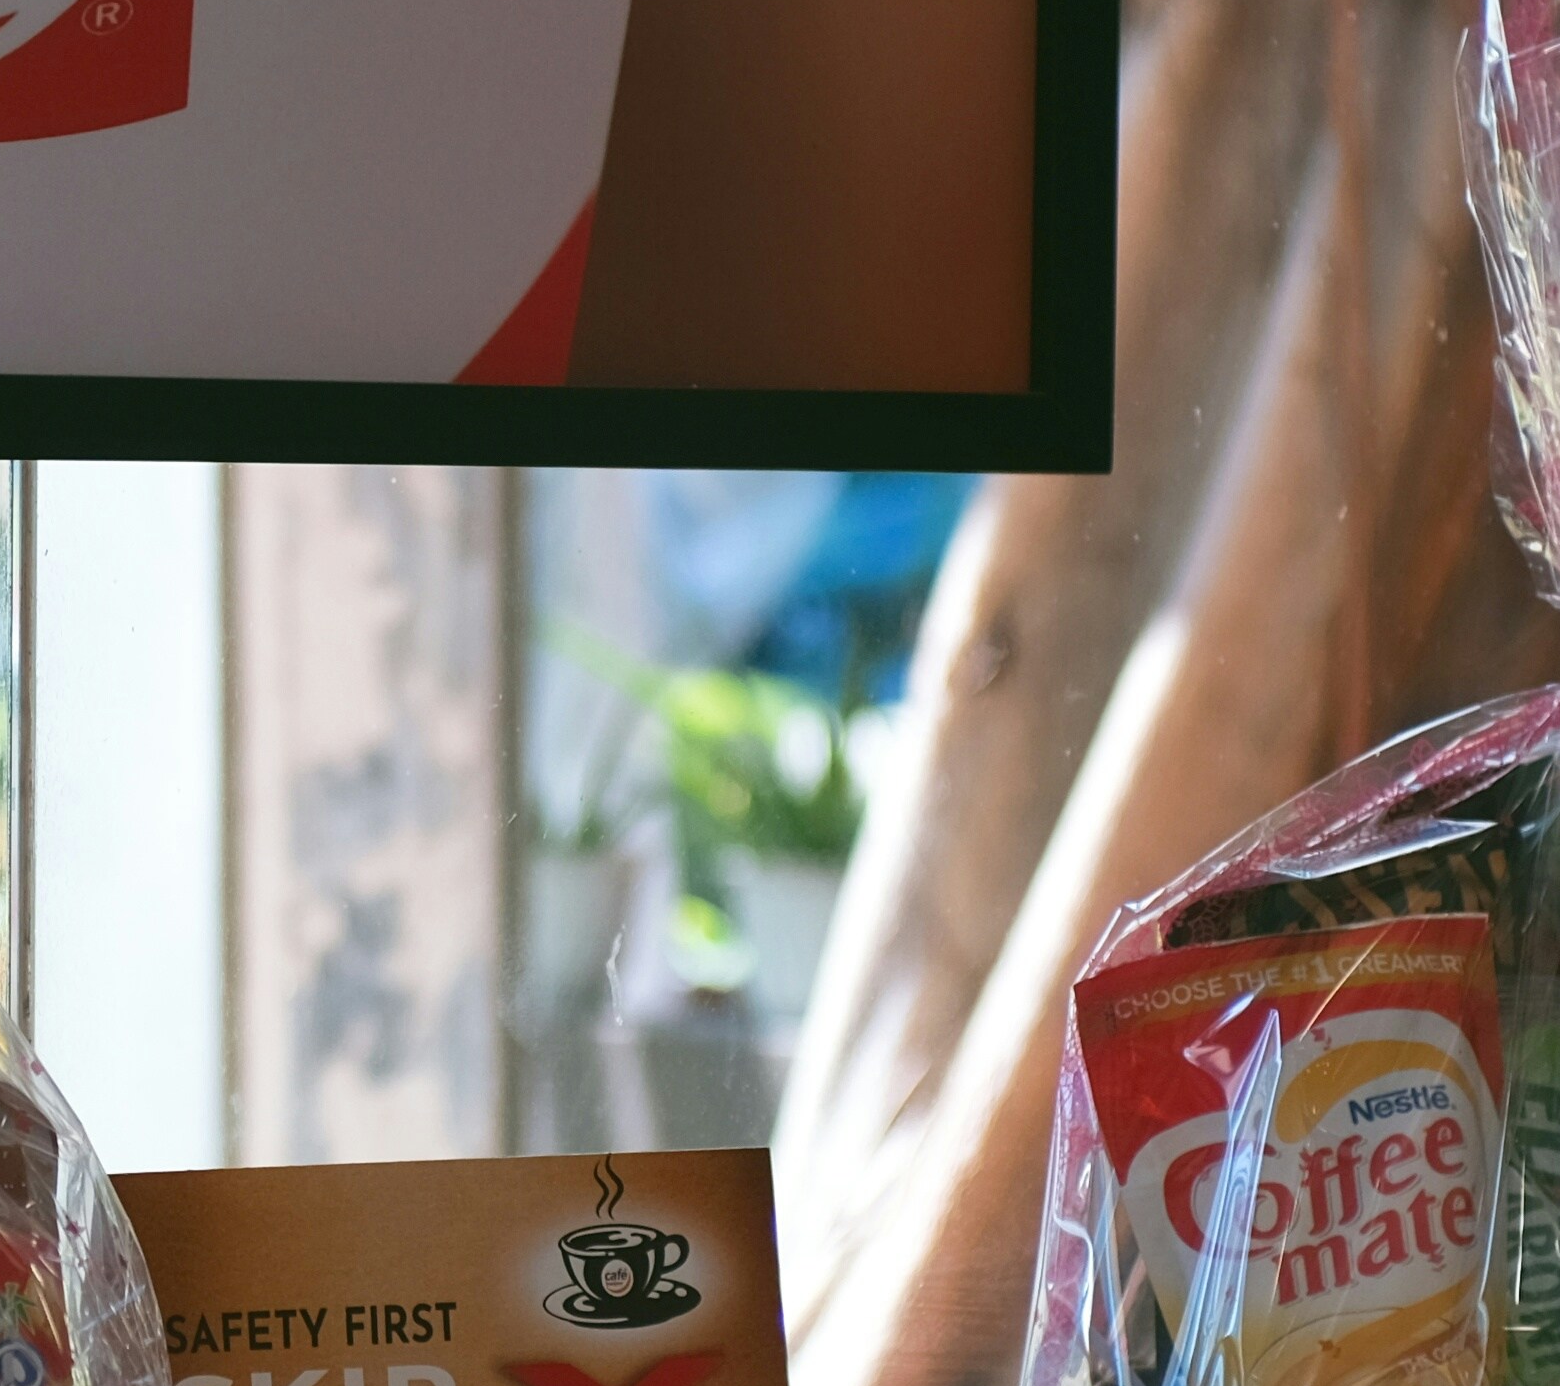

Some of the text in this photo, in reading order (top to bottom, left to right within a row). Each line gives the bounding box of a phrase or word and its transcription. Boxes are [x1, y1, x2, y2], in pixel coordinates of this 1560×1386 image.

[1114, 977, 1226, 1019] CHOOSE
[1231, 967, 1281, 994] THE
[1164, 1116, 1467, 1258] Coffee
[1273, 1187, 1477, 1306] mate
[166, 1302, 457, 1354] SAFETY FIRST
